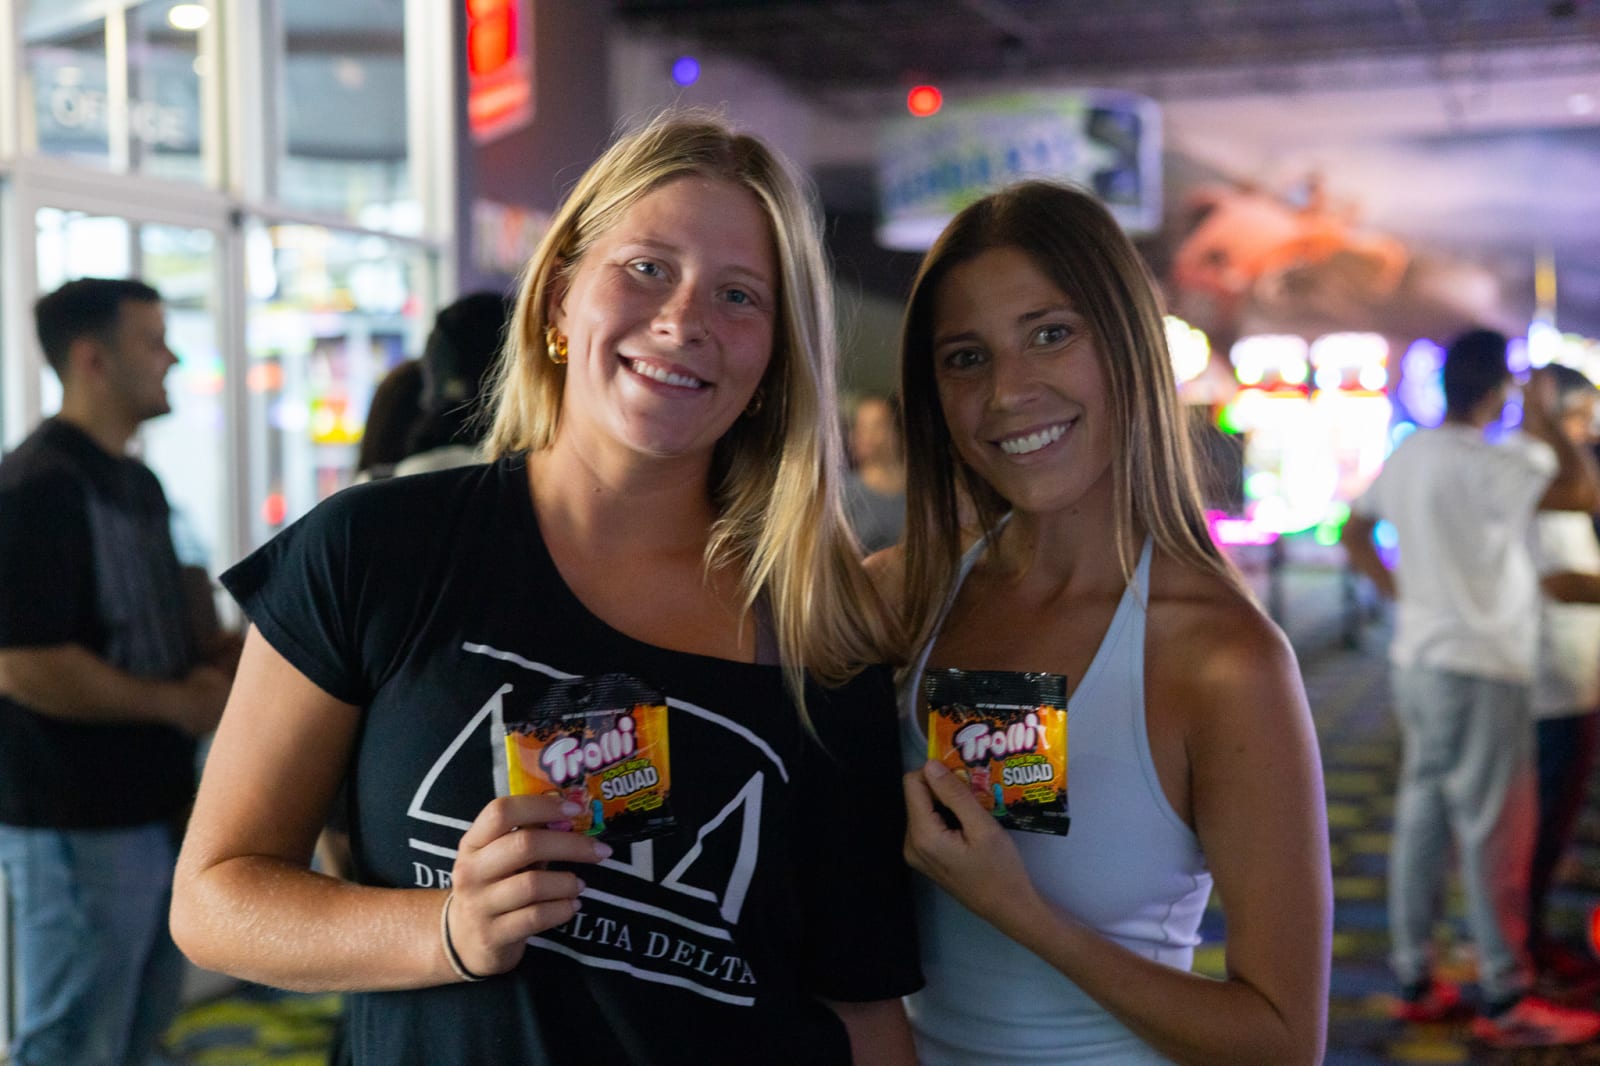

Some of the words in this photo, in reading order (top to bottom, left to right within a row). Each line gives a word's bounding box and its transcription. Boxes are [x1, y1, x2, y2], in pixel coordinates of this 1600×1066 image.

[52, 86, 186, 146] OFCE
[542, 715, 635, 783] Trolli
[955, 712, 1038, 762] Trolli
[600, 766, 659, 800] SQUAD
[1002, 763, 1054, 786] SQUAD
[556, 911, 633, 952] LTA
[643, 930, 757, 985] DELTA
